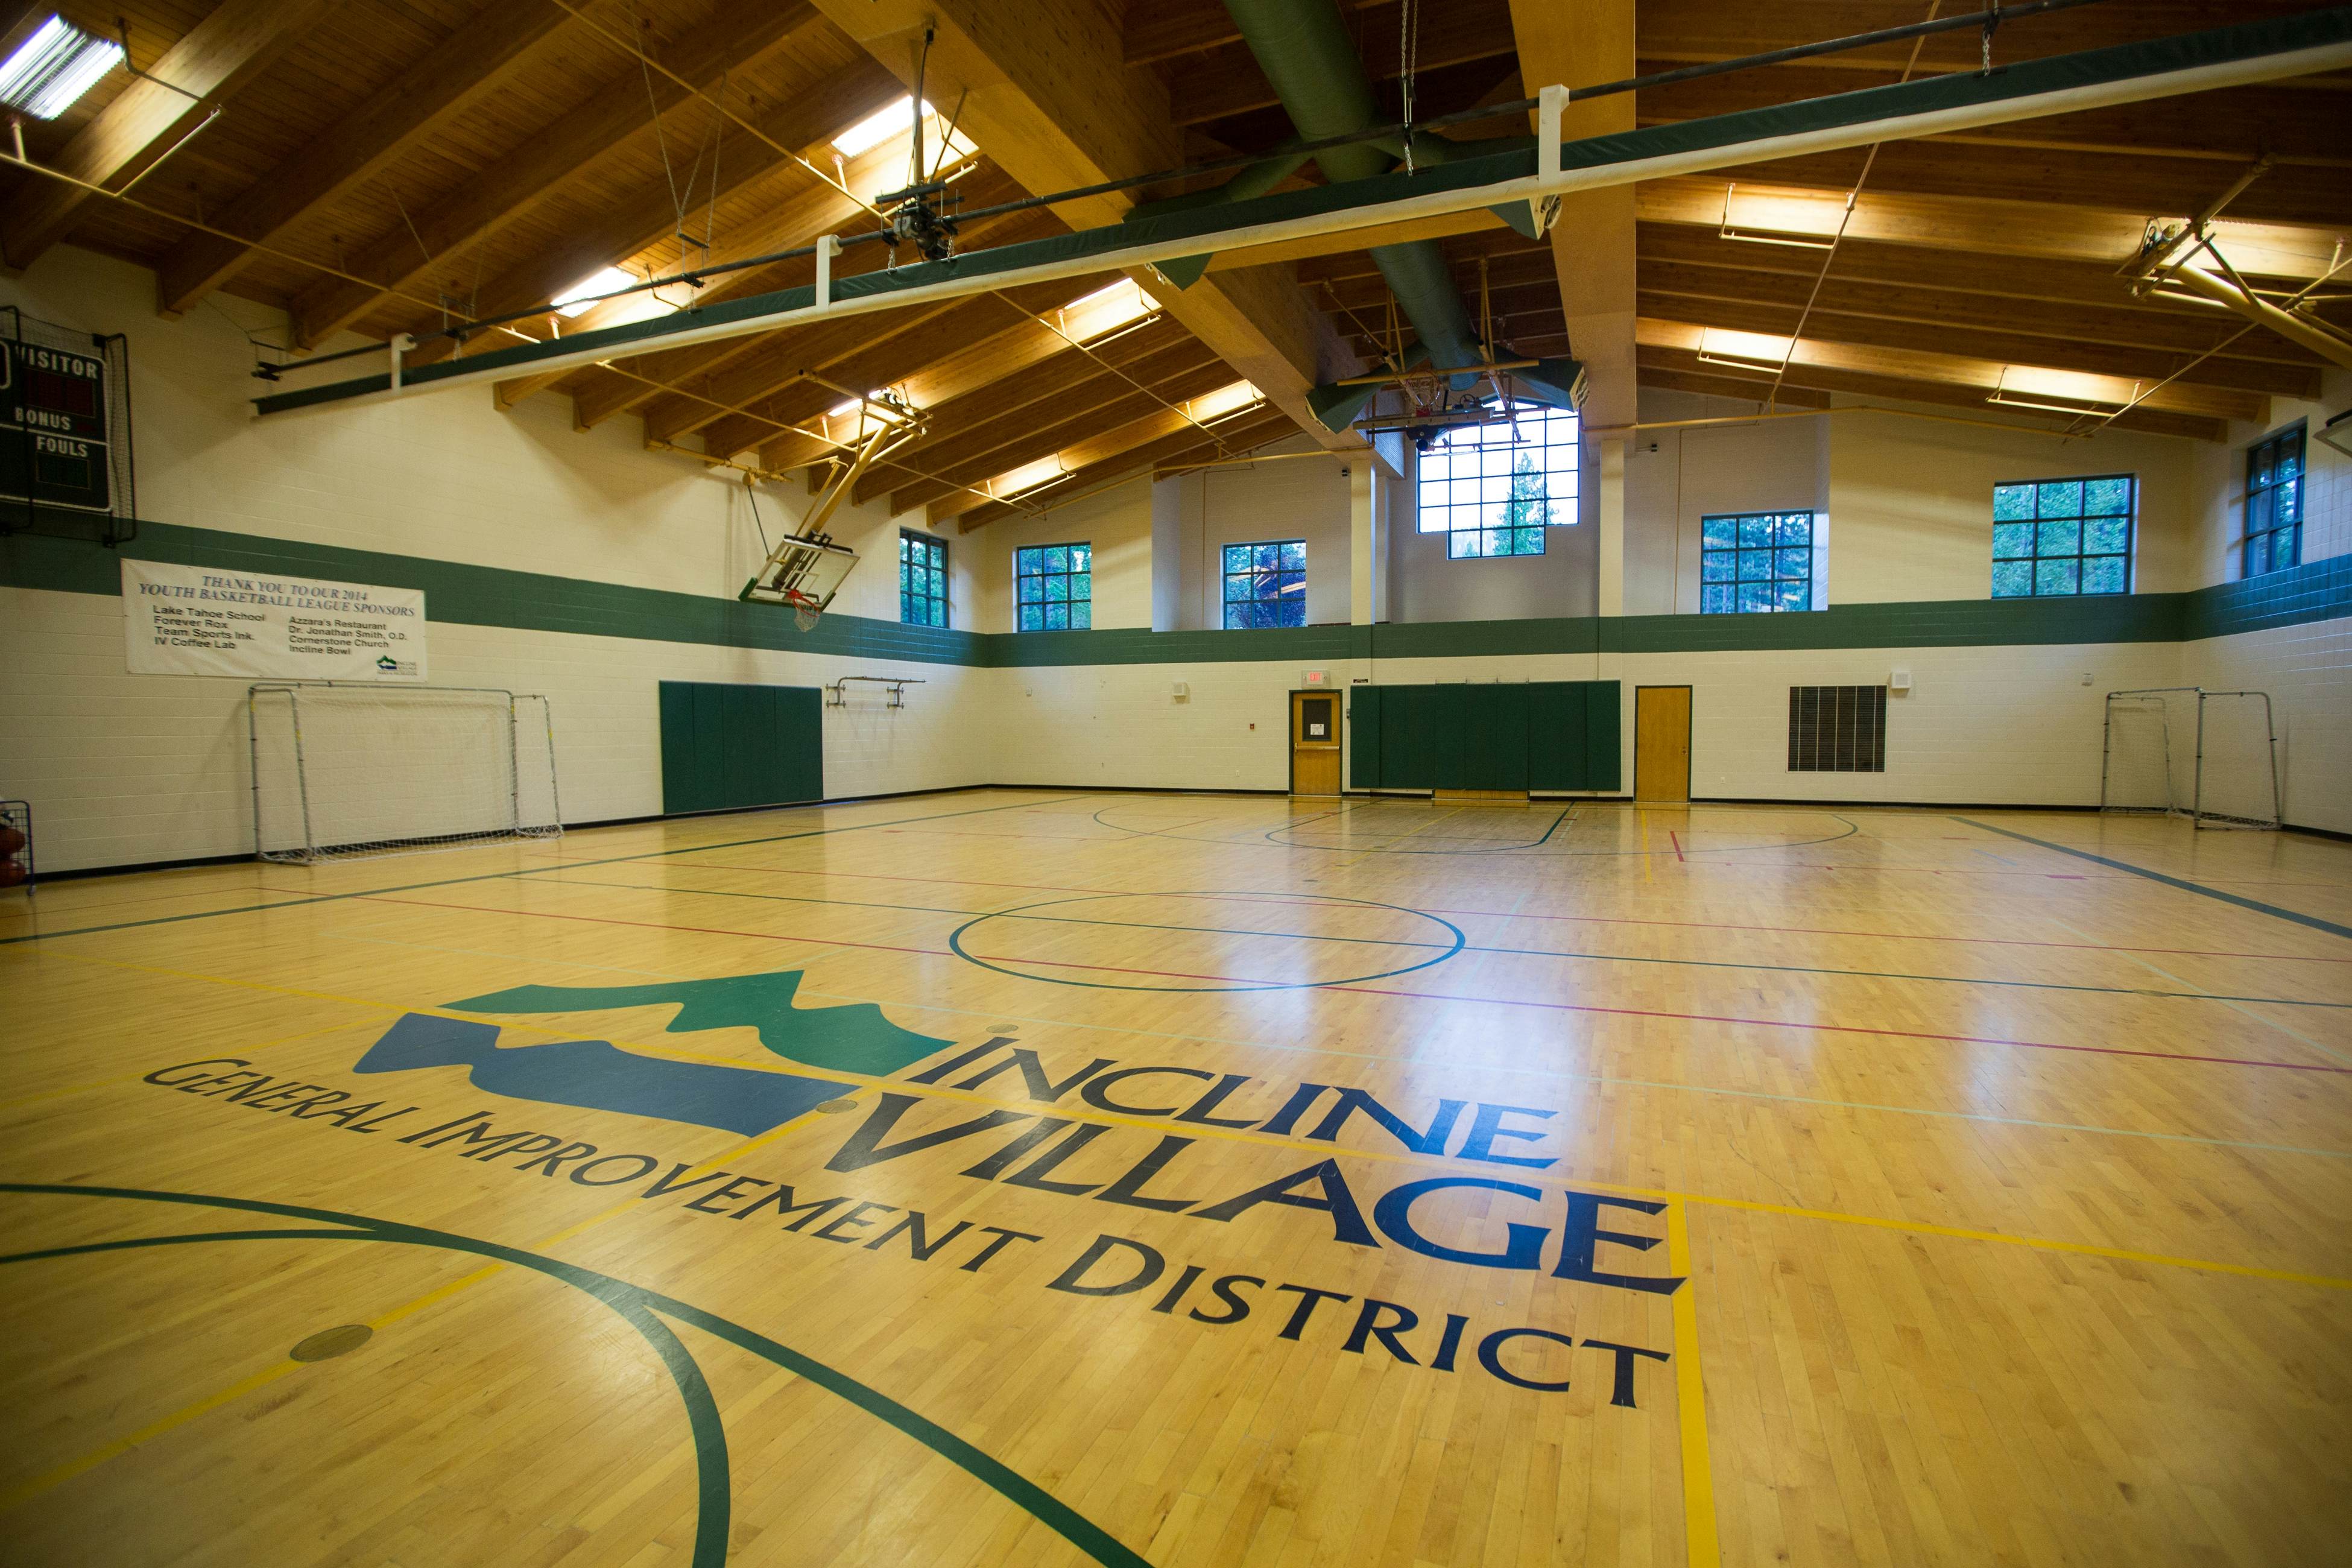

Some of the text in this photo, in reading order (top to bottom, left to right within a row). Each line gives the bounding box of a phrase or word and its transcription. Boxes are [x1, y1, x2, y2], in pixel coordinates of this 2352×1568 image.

[14, 406, 72, 431] BONUS
[36, 435, 89, 458] FOULS
[202, 576, 367, 600] THANK YOU TO OUR 2014
[139, 583, 414, 616] YOUTH BASKETBALL LEAGUE SPONSORS
[153, 605, 265, 621] Lake Tahoe School
[153, 616, 228, 628] Forever Rox
[289, 616, 387, 630] Azzara's Restaurant
[154, 626, 254, 640] Team Sports Ink.
[288, 625, 303, 634] Dr.
[306, 626, 352, 637] Jonathan
[356, 630, 386, 640] Smith,
[154, 636, 236, 649] IV Coffee Lab
[289, 635, 389, 648] Cornerstone Church
[289, 645, 323, 654] Incline
[1309, 672, 1321, 681] EXIT
[904, 1037, 1562, 1169] INCLINE
[823, 1092, 1688, 1296] VILLAGE
[142, 1058, 1671, 1409] GENERAL IMPROVEMENT DISTRICT
